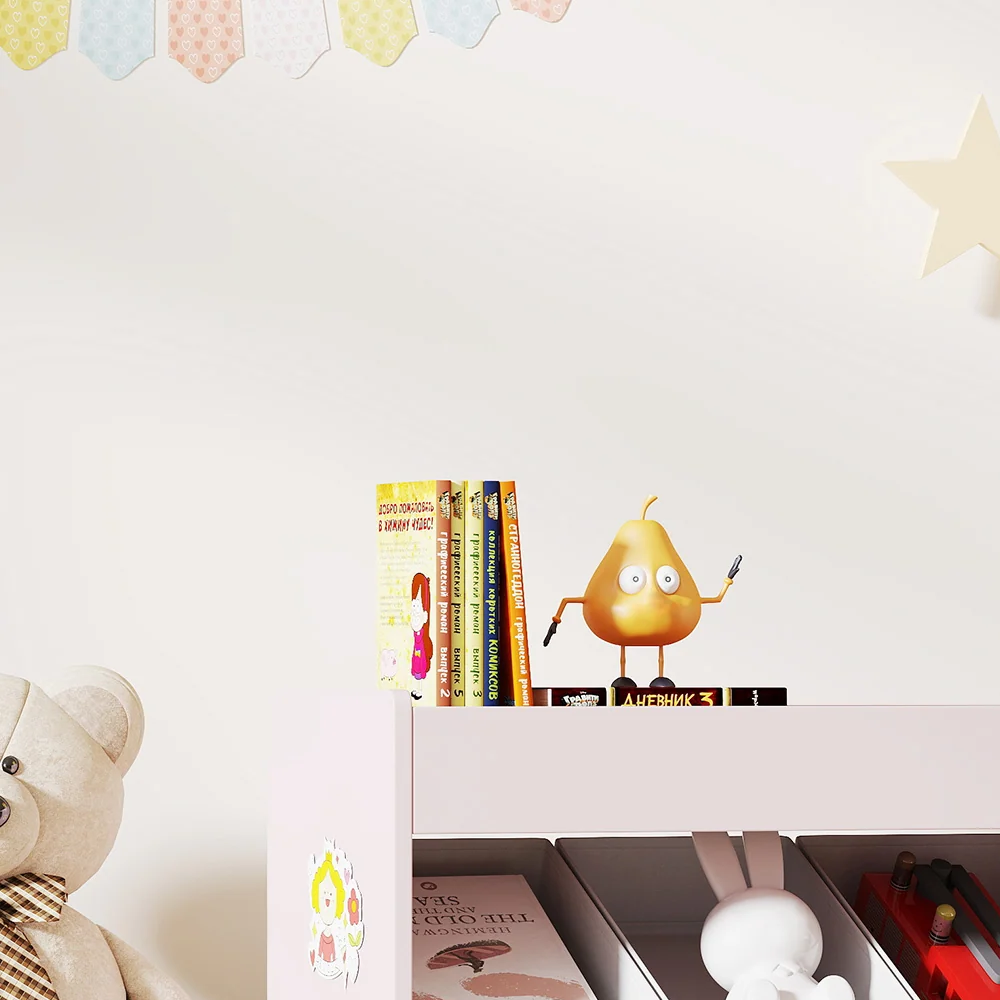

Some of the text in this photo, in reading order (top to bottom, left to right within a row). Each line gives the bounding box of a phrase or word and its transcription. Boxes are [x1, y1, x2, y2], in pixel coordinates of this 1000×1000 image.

[437, 602, 448, 634] роман
[451, 603, 461, 634] роман
[470, 603, 480, 634] роман
[485, 530, 498, 700] коллекция коротких КОМИКСОВ
[508, 523, 524, 609] СТРАННОГЕДДОН
[518, 678, 530, 705] роман
[437, 647, 448, 684] выпуск
[451, 648, 461, 684] выпуск
[440, 689, 451, 697] 2
[454, 689, 463, 697] 5
[621, 692, 714, 706] ДНЕВНИК 3
[413, 895, 460, 907] SEA
[447, 906, 476, 914] AND
[424, 914, 477, 926] OLD
[481, 913, 534, 924] THE
